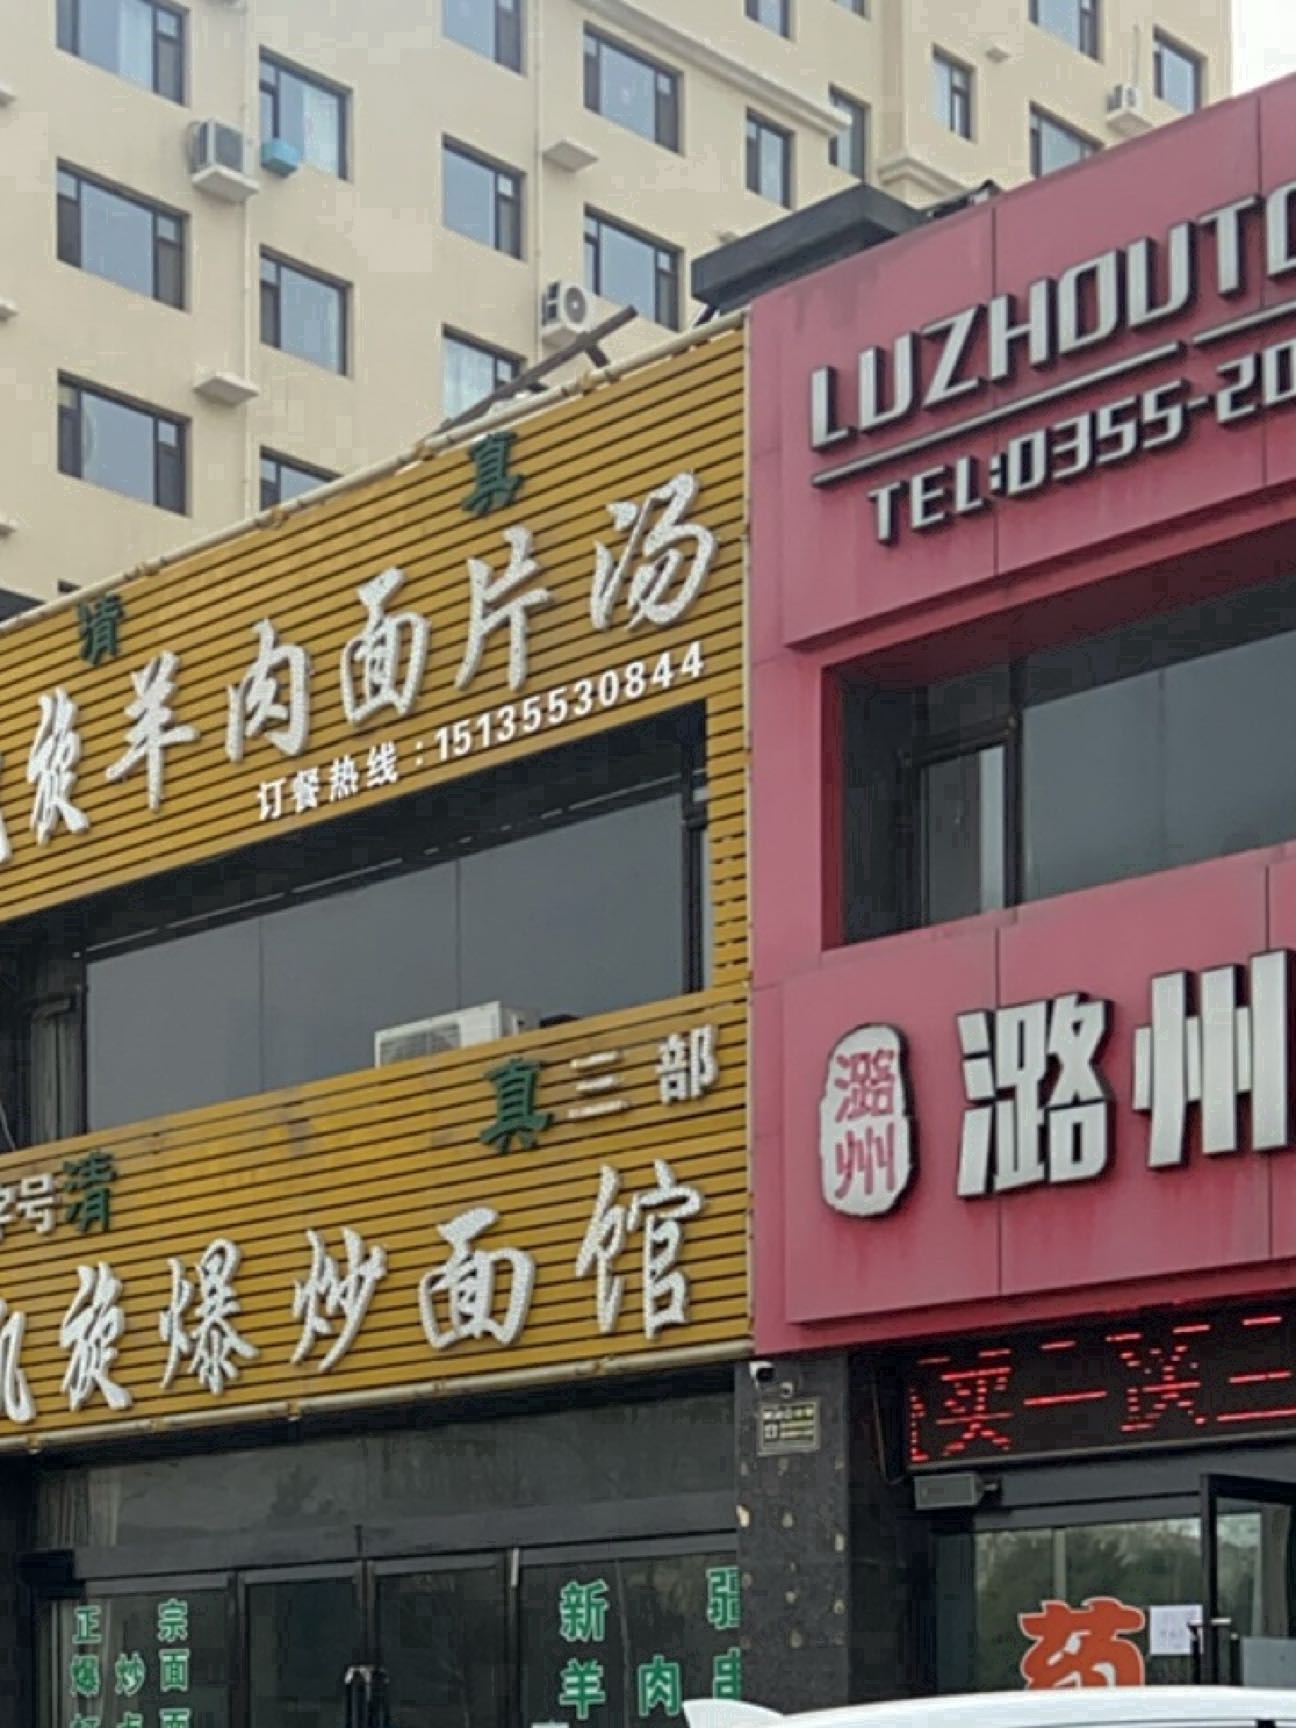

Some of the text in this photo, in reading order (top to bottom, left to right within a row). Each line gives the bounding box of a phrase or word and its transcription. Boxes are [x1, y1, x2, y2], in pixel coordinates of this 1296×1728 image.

[566, 1025, 719, 1121] 三部
[834, 1049, 896, 1199] 潞州
[956, 949, 1290, 1197] 潞州
[1018, 1596, 1146, 1690] 药
